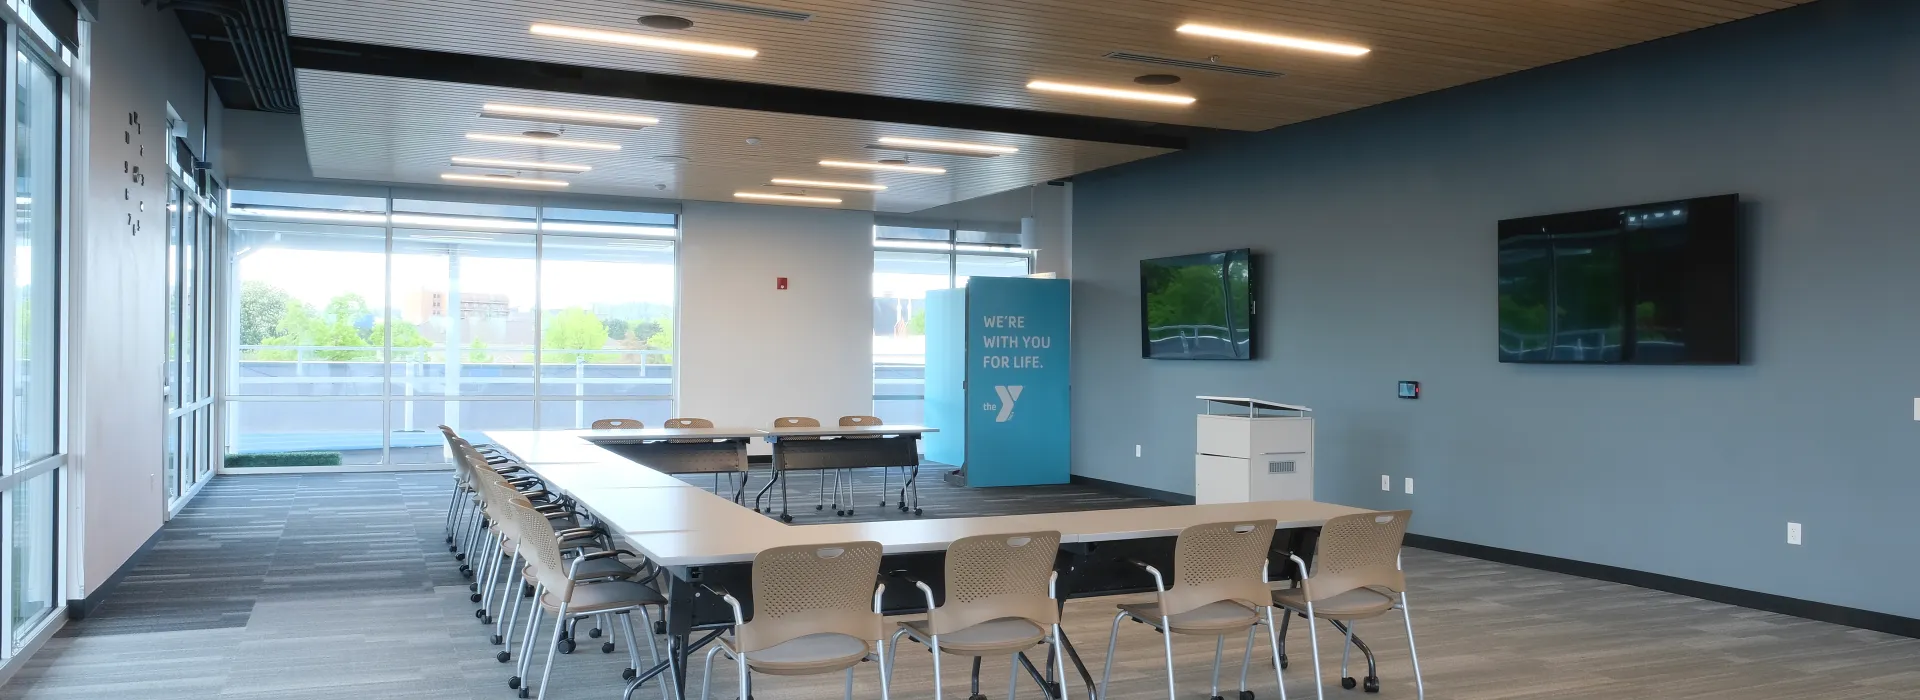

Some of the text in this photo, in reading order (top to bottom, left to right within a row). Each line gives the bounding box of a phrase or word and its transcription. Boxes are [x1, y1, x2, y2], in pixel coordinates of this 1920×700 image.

[983, 315, 1025, 329] WE'RE
[983, 335, 1051, 349] WITH YOU
[983, 355, 1044, 369] FOR LIFE.
[983, 402, 997, 411] the
